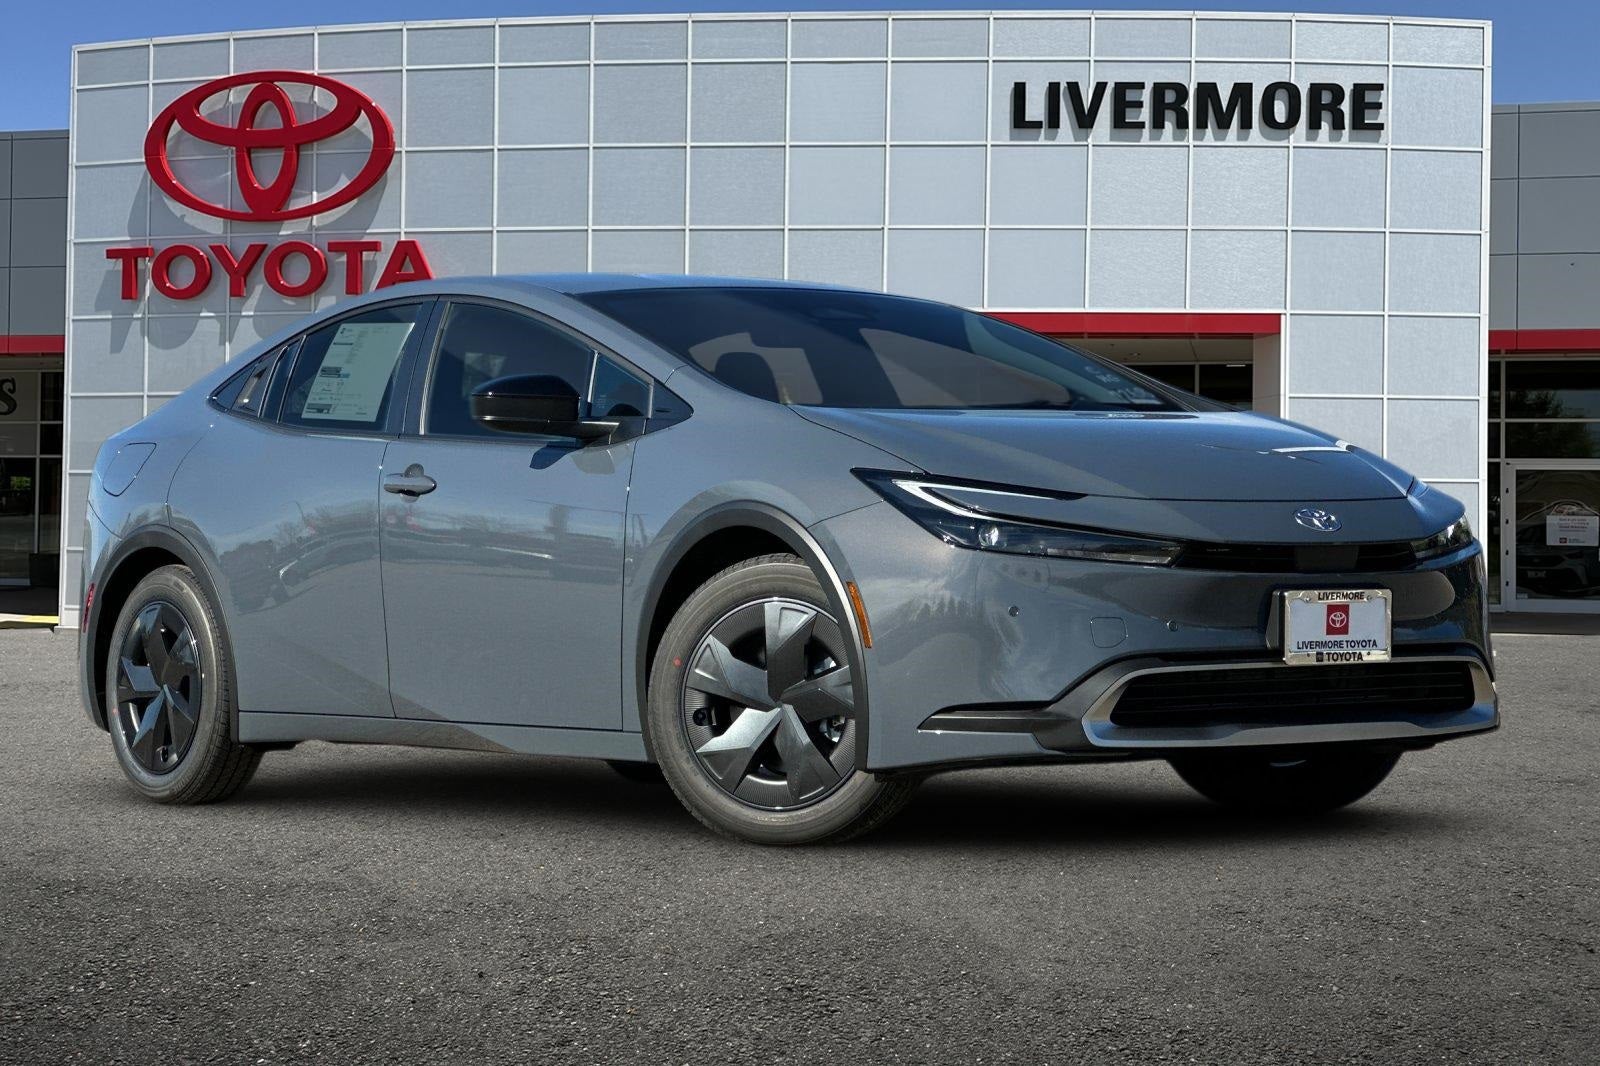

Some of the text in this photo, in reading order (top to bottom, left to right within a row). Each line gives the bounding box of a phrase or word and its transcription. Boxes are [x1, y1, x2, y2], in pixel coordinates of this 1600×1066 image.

[1012, 81, 1385, 131] LIVERMORE
[105, 239, 435, 300] TOYOTA
[1318, 592, 1364, 600] LIVERMORE
[1297, 639, 1377, 649] LIVERMORE TOYOTA
[1326, 652, 1363, 661] TOYOTA
